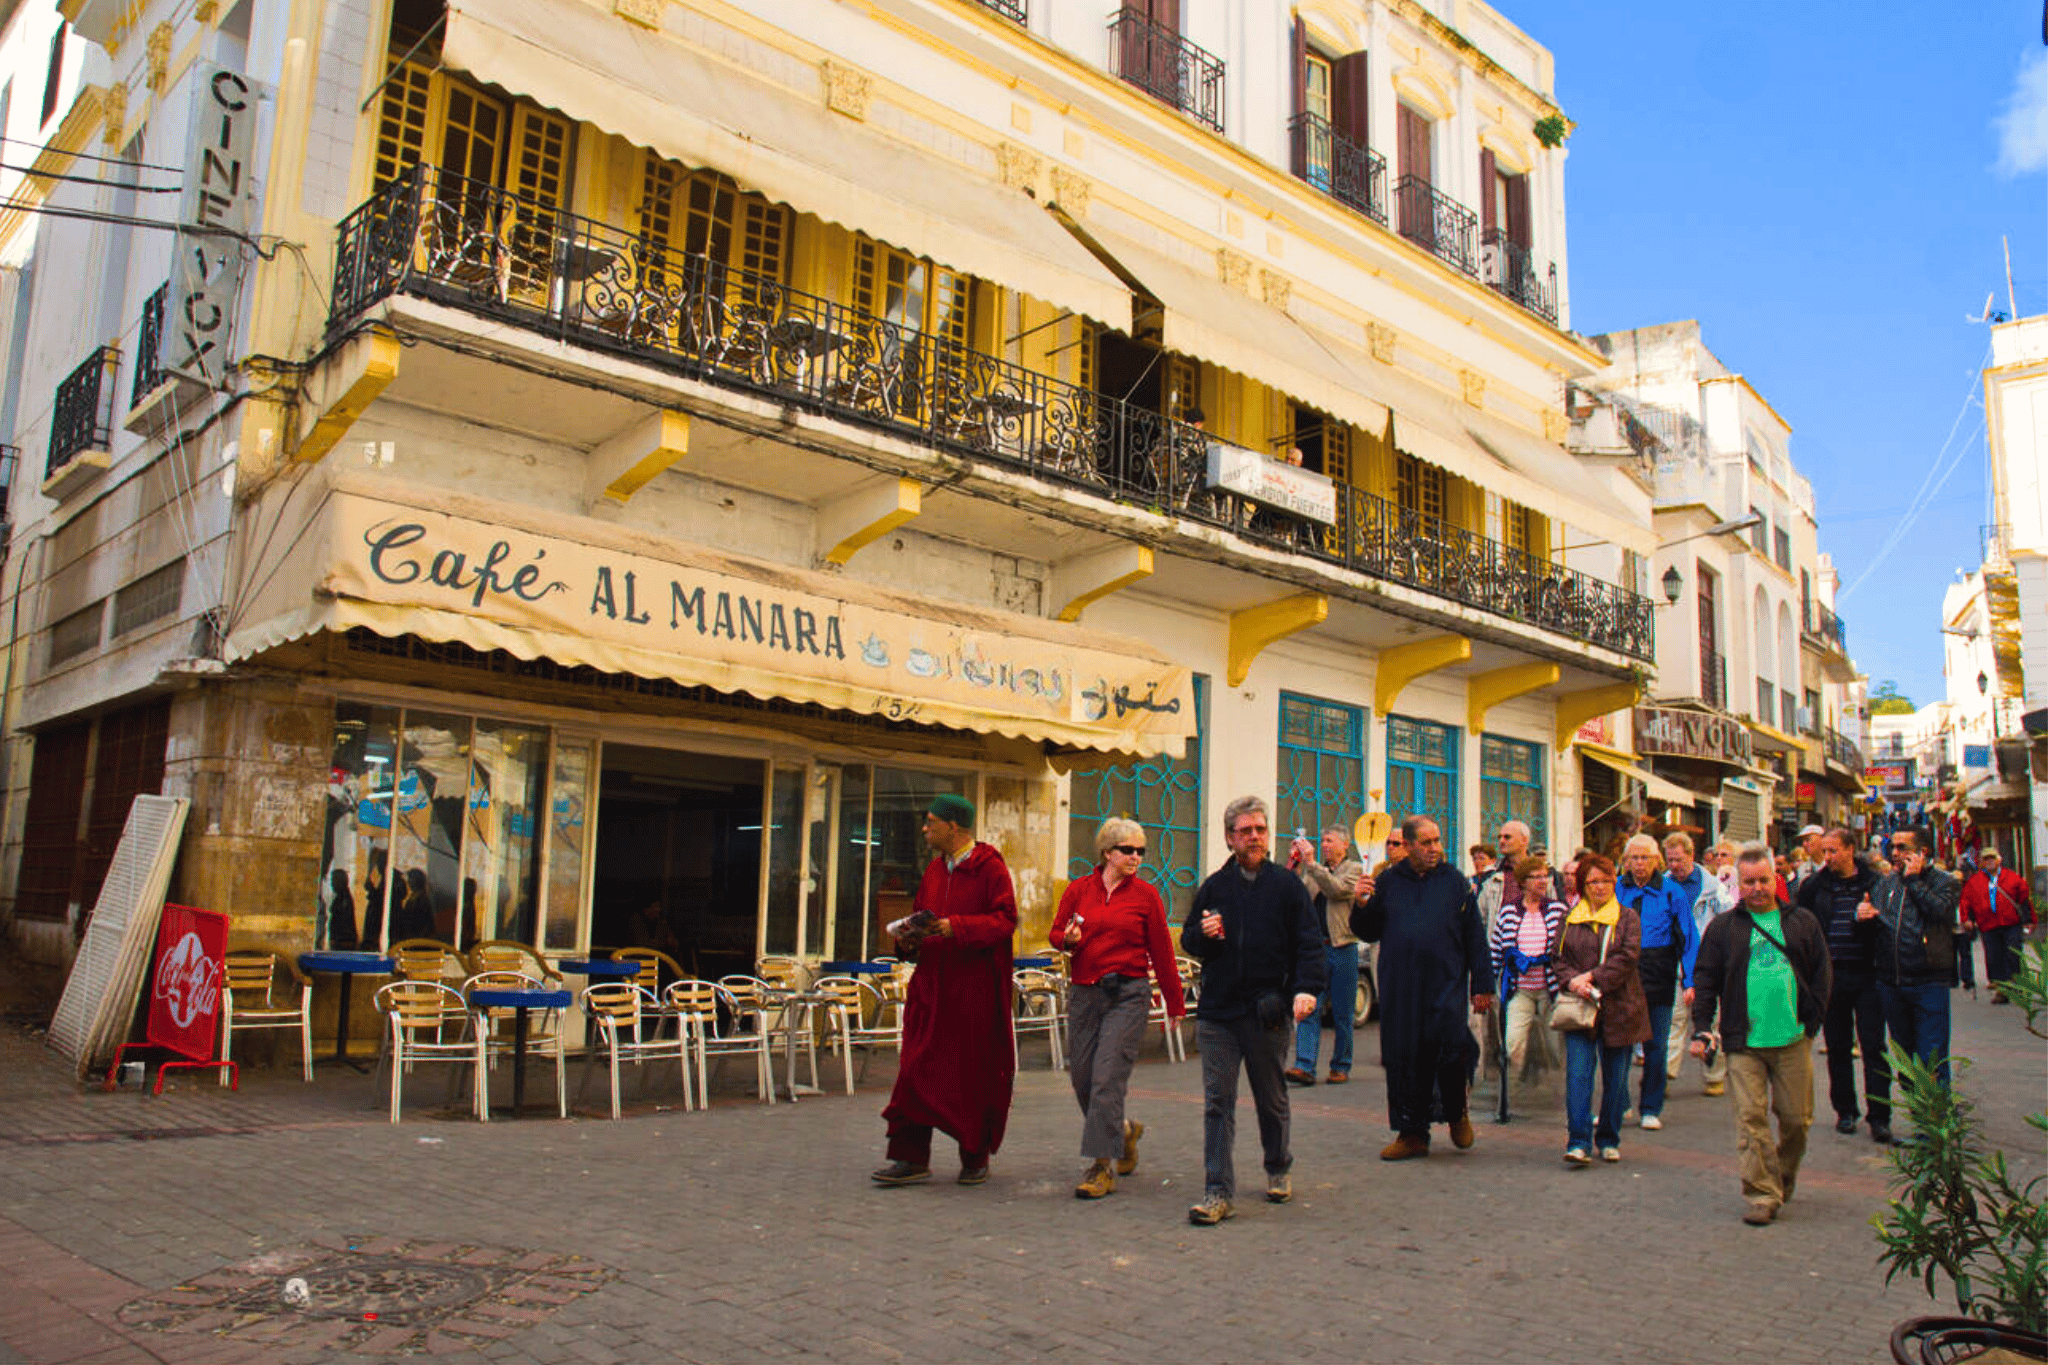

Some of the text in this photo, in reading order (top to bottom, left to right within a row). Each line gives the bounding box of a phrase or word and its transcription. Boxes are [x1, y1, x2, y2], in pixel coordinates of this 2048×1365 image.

[197, 71, 248, 229] CINE
[364, 517, 846, 661] Café AL MANARA
[155, 945, 220, 1016] Coca-Cola
